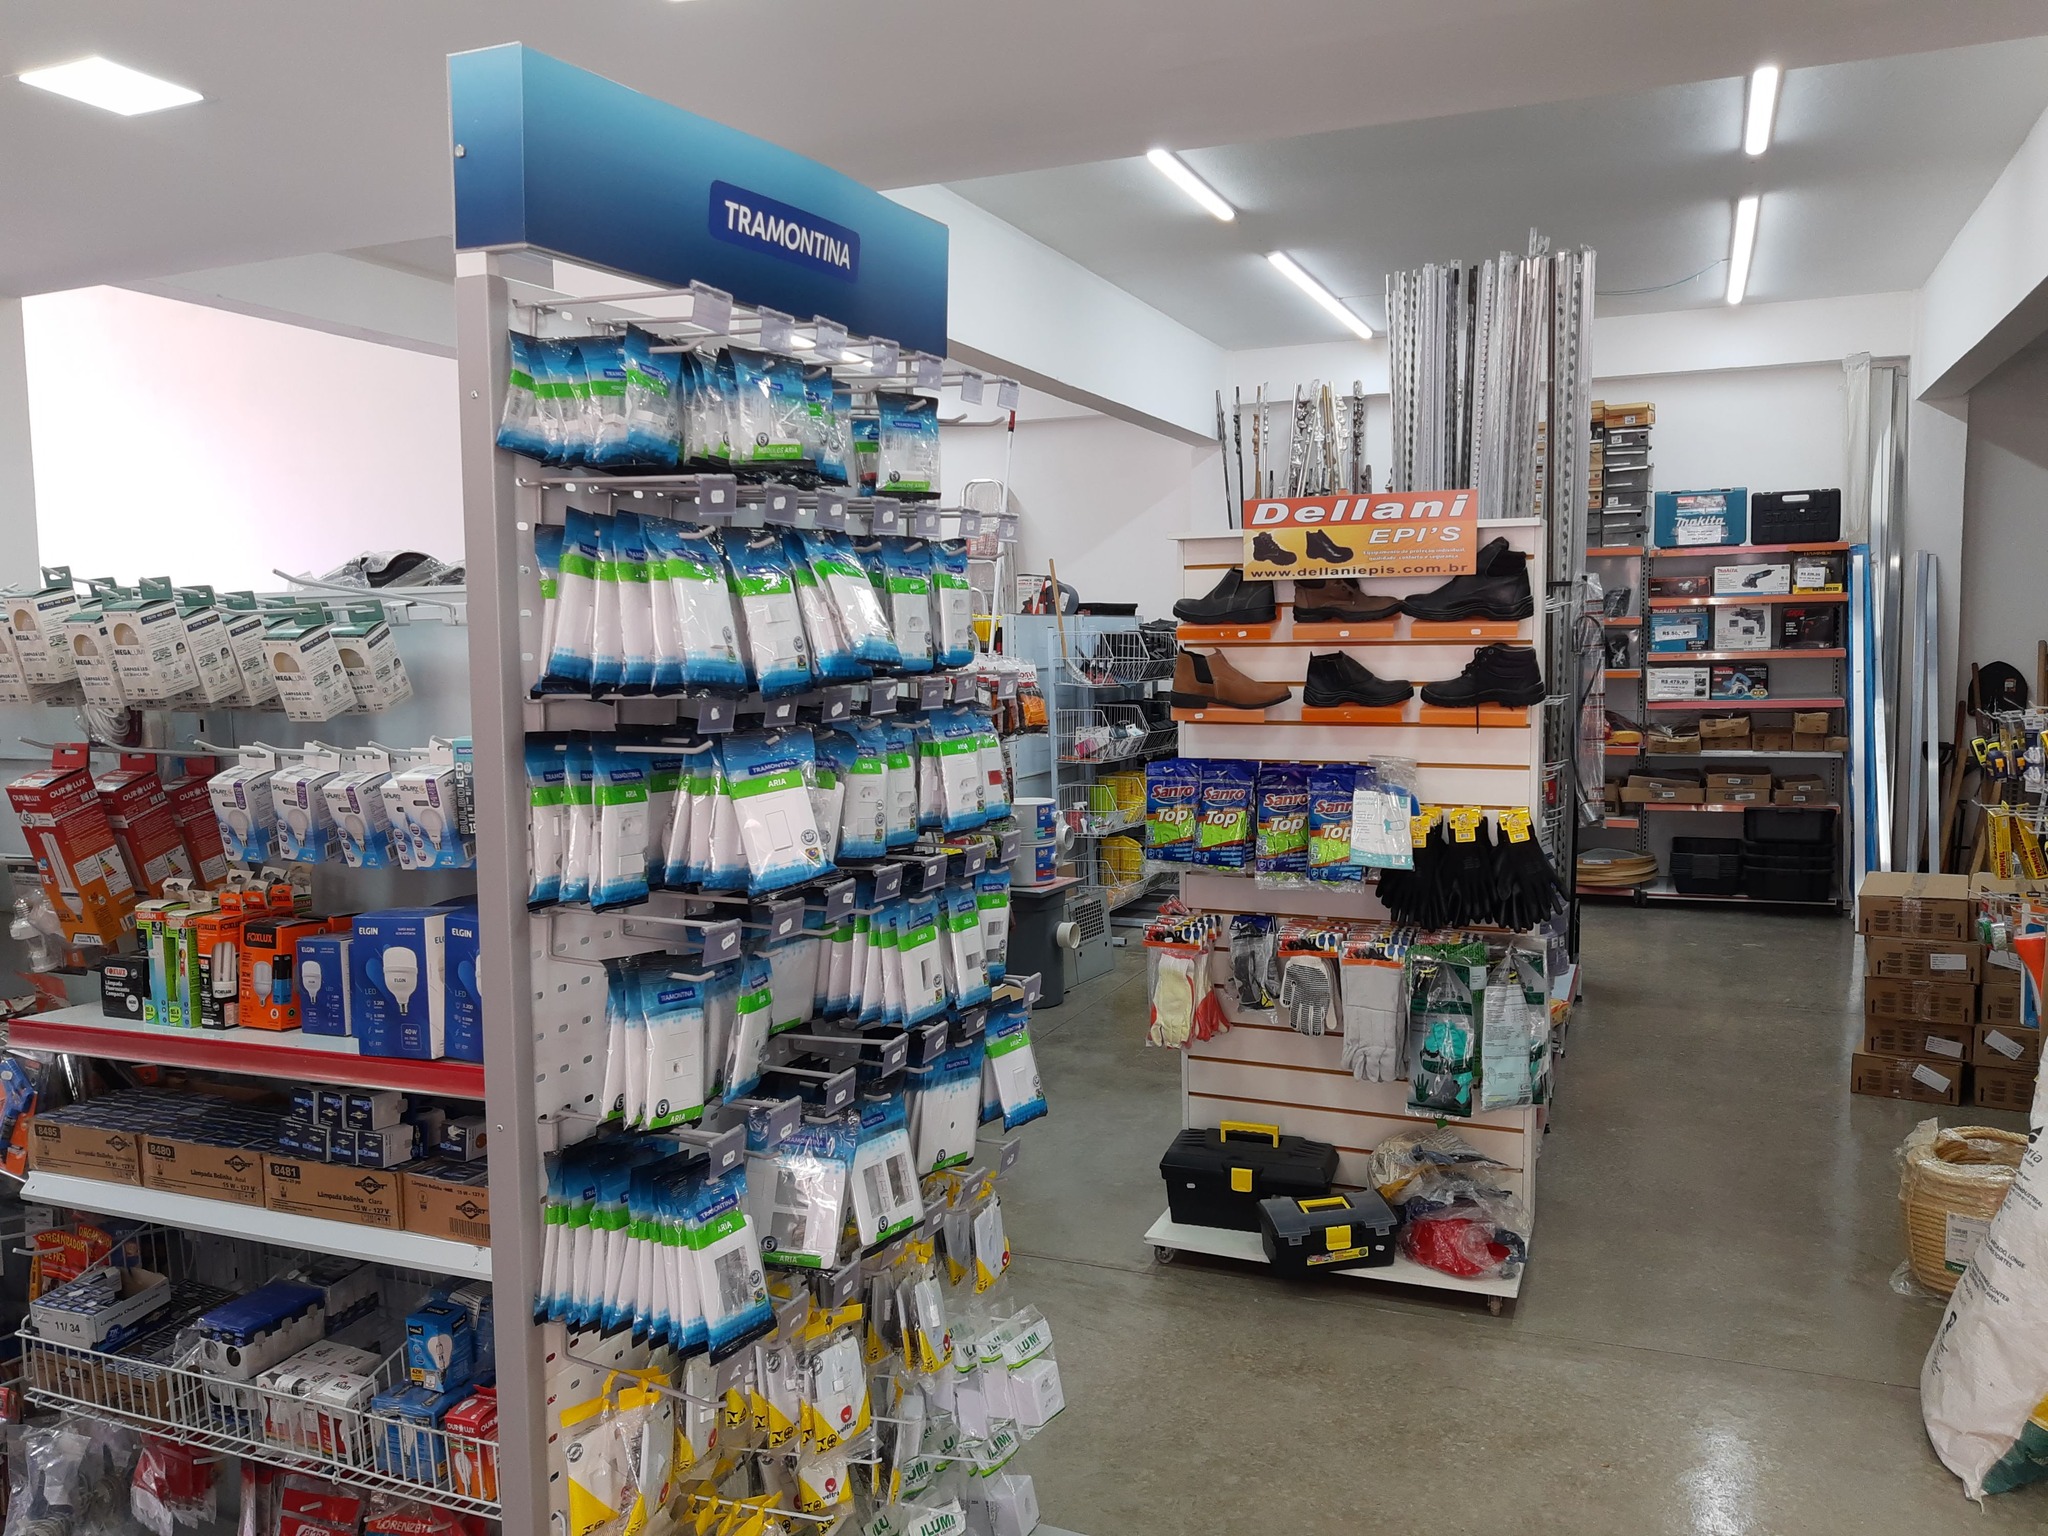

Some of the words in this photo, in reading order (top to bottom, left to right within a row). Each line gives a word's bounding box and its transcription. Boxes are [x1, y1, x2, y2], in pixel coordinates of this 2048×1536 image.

[724, 200, 851, 270] TRAMONTINA
[1251, 494, 1469, 525] Dellani
[1368, 526, 1462, 544] EPI'S
[1251, 563, 1468, 578] www.dellaniepis.com.br
[752, 761, 795, 773] TRAMONTINA
[768, 778, 787, 788] ARIA
[1151, 785, 1195, 799] Sanro
[1203, 787, 1246, 801] Sanro
[1265, 794, 1308, 807] Sanro
[1314, 800, 1352, 814] Sanr
[1156, 808, 1188, 825] Top
[1205, 811, 1238, 828] Top
[1270, 817, 1305, 834] Top
[137, 912, 156, 920] OSRAM
[247, 932, 273, 943] FOXLUX
[359, 927, 378, 935] ELGIN
[451, 928, 472, 938] ELGIN
[917, 933, 928, 942] ARIA
[106, 968, 126, 976] FOXLUX
[670, 1114, 686, 1124] ARIA
[274, 1165, 296, 1177] 8481
[355, 1181, 388, 1190] BRASFORT
[317, 1191, 342, 1201] Lâmpada
[343, 1194, 364, 1203] Bolinha
[717, 1221, 732, 1234] ARIA
[38, 1233, 86, 1251] ORGANIZADOR
[778, 1255, 798, 1264] ARIA
[2007, 1252, 2026, 1269] LONGE
[1989, 1285, 2010, 1303] CONTER
[69, 1323, 80, 1333] 34
